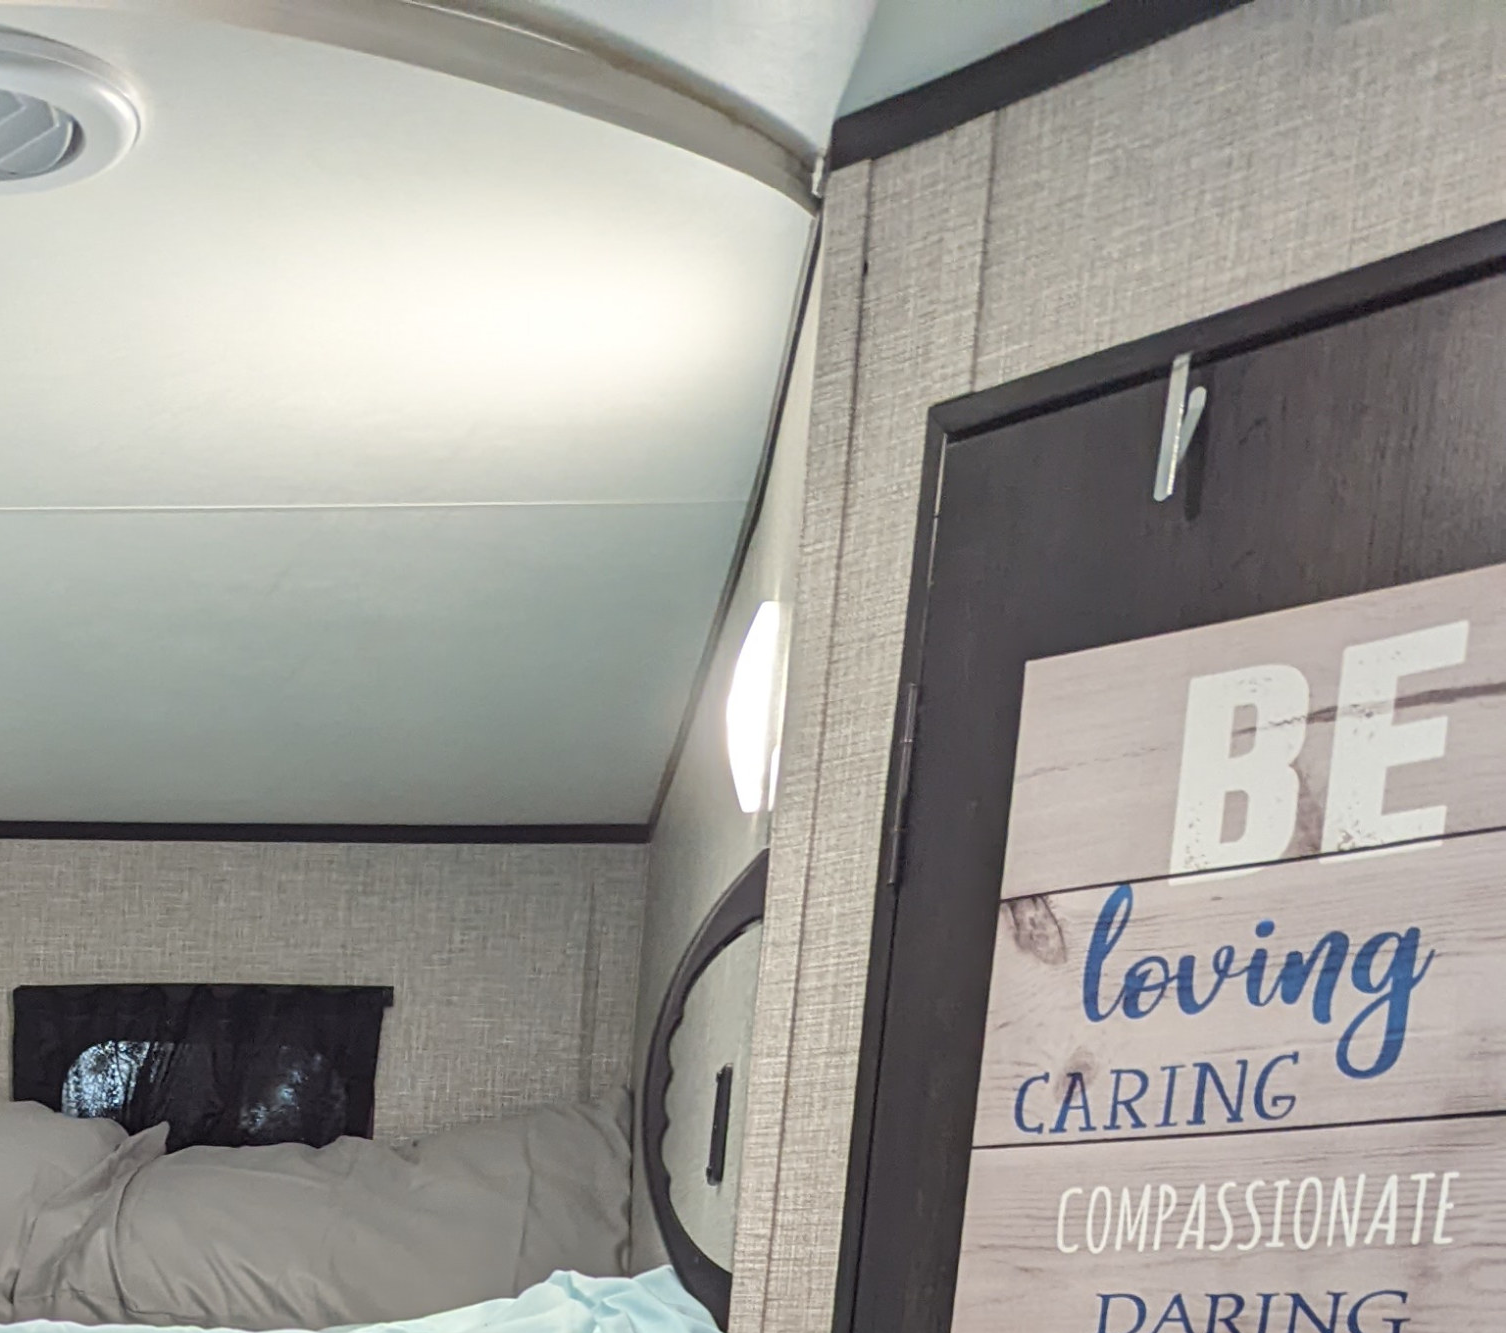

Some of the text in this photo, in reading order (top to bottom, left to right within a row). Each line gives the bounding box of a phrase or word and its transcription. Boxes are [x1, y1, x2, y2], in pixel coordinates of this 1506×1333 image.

[1168, 620, 1470, 886] BE
[1082, 883, 1436, 1079] loving
[1013, 1052, 1300, 1135] CARING
[1055, 1171, 1461, 1254] COMPASSIONATE
